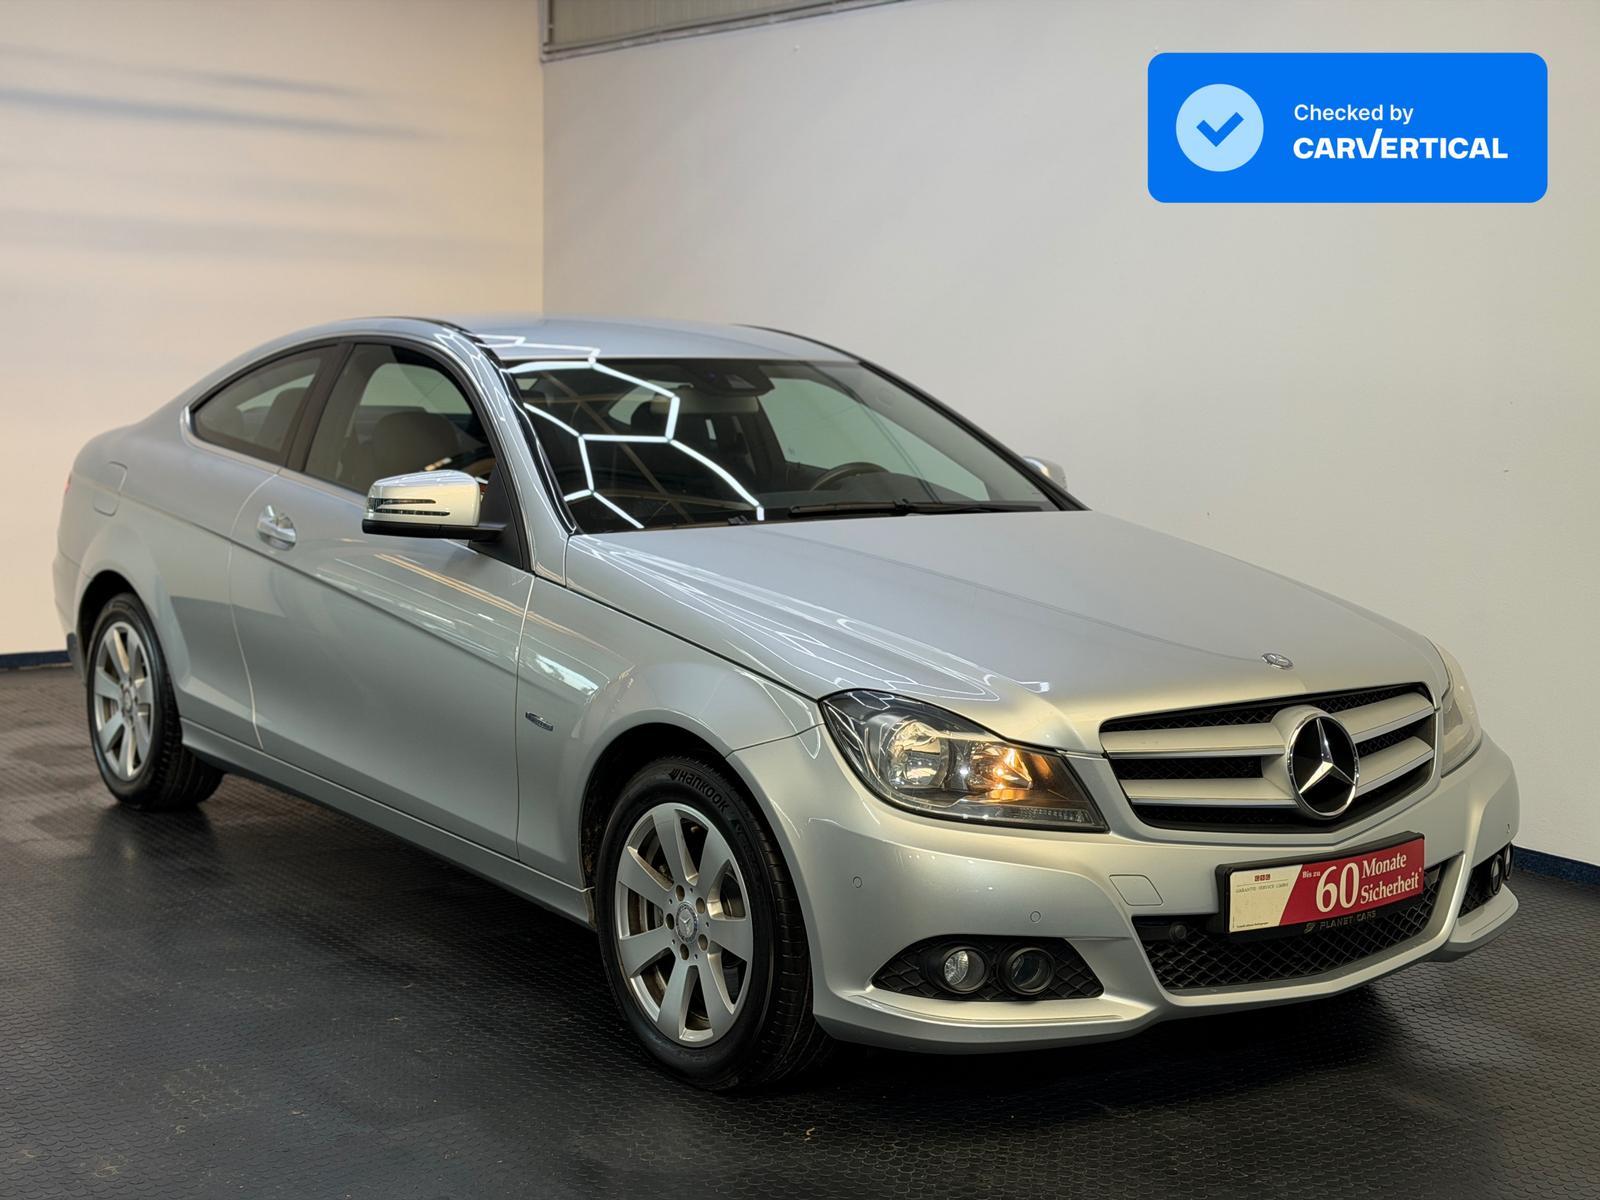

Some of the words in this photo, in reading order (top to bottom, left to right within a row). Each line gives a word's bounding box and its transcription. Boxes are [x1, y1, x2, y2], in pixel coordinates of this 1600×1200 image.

[1302, 871, 1312, 879] Bis
[1361, 852, 1407, 879] Monate
[1316, 862, 1360, 913] 60
[1319, 915, 1354, 930] PLANET
[1356, 910, 1377, 922] CARS
